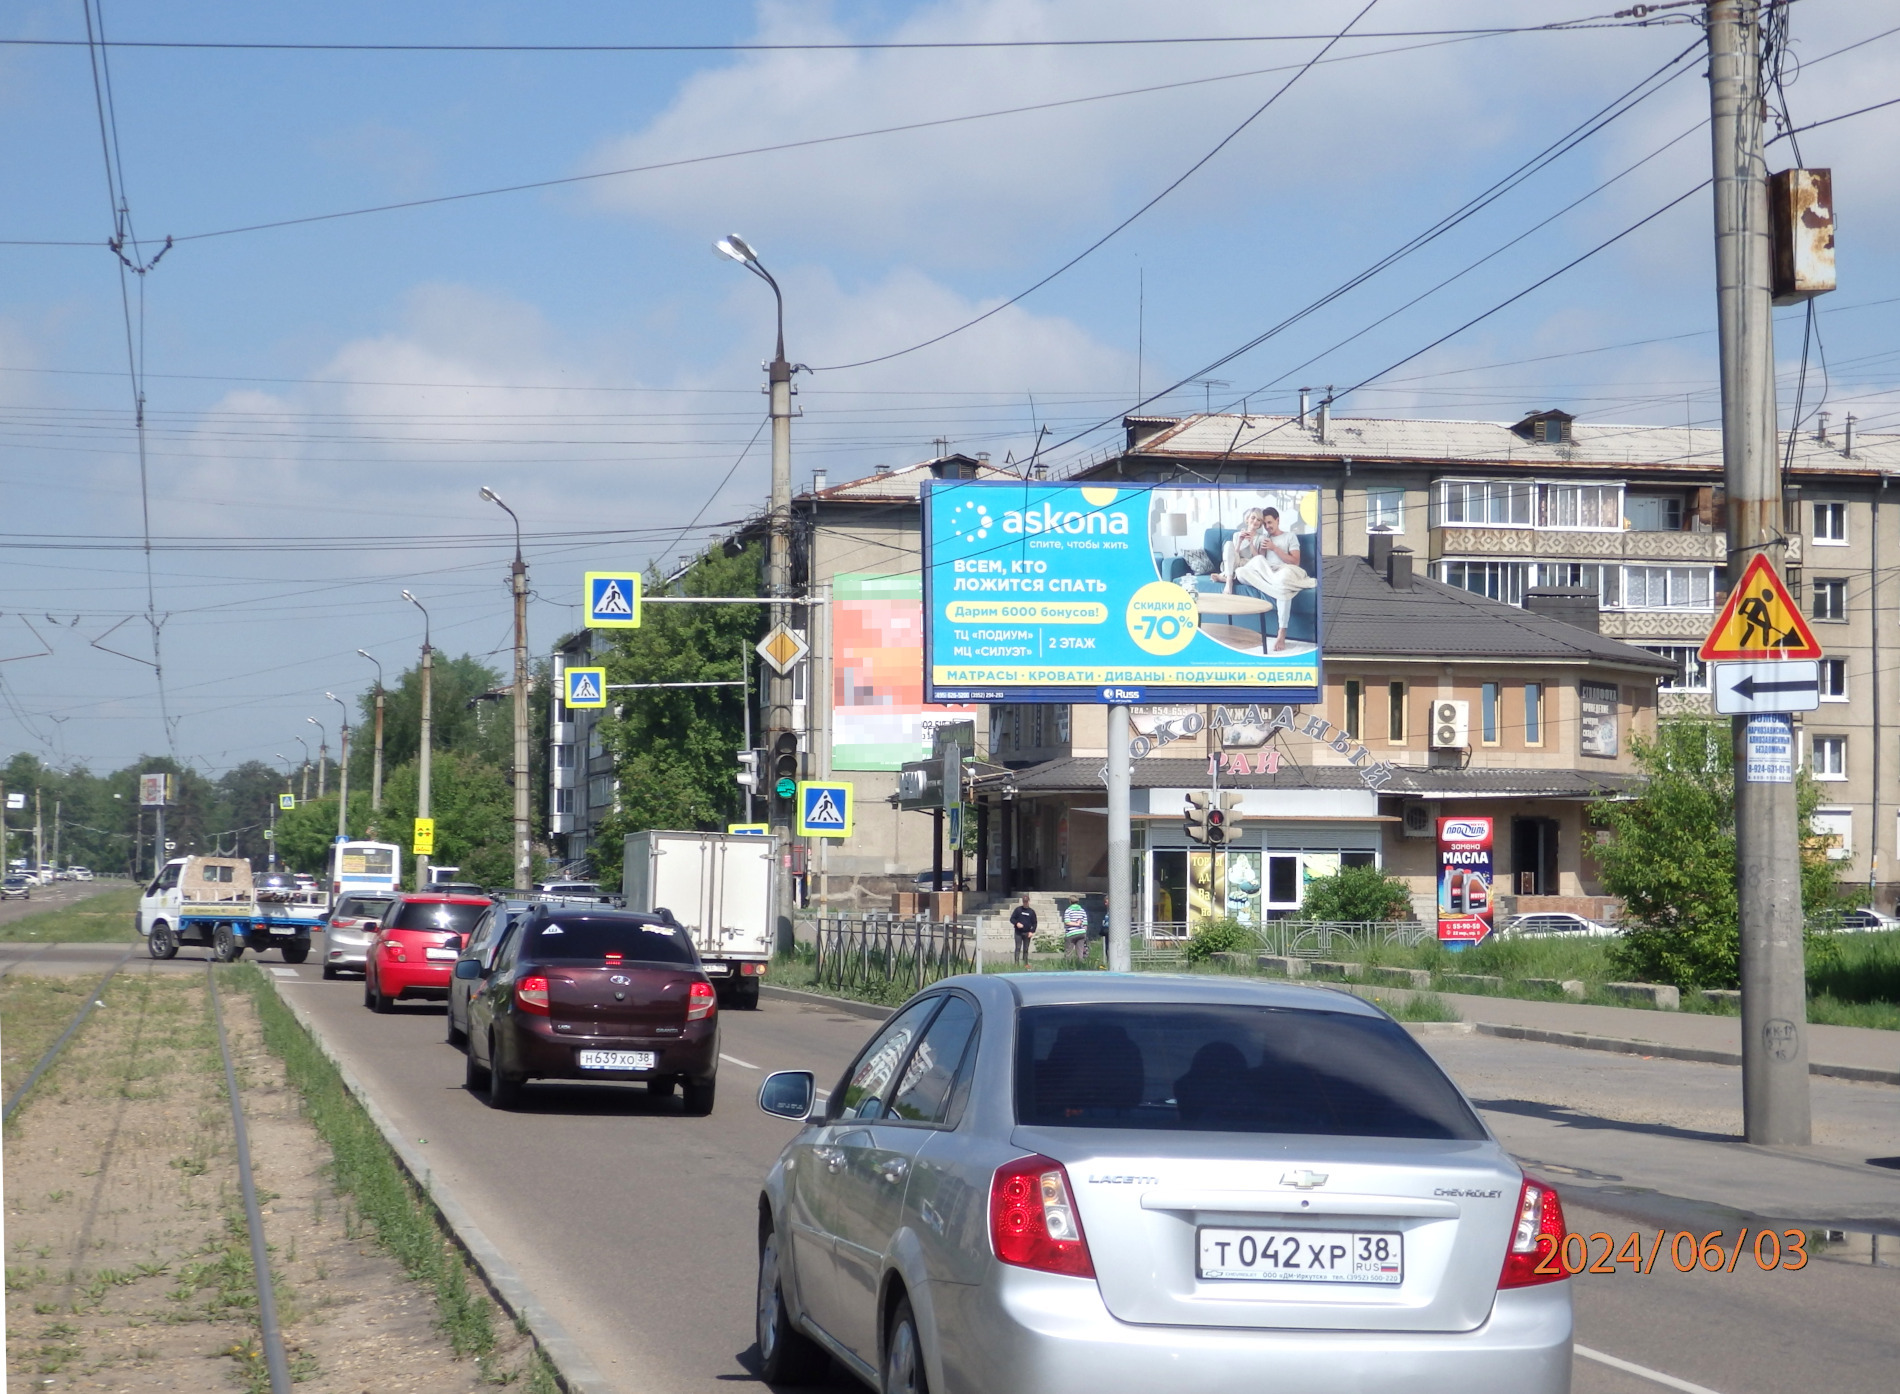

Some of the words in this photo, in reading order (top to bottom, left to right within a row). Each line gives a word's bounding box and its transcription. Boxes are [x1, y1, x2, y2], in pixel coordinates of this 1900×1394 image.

[1002, 502, 1129, 535] askona
[1029, 540, 1064, 550] спите,
[1067, 540, 1100, 549] чтобы
[1103, 541, 1128, 550] жить
[953, 560, 1007, 575] ВСЕМ,
[1011, 560, 1047, 573] КТО
[953, 578, 1044, 592] ЛОЖИТСЯ
[1048, 579, 1107, 592] СПАТЬ
[954, 606, 998, 619] Дарим
[1002, 607, 1037, 617] 6000
[1041, 607, 1099, 619] бонусов!
[1133, 602, 1175, 612] СКИДКИ
[1177, 602, 1192, 612] ДО
[1133, 615, 1194, 640] -70%
[954, 630, 969, 641] ТЦ
[972, 630, 1033, 641] «ПОДИУМ»
[1049, 638, 1057, 648] 2
[1059, 638, 1096, 649] ЭТАЖ
[954, 647, 972, 658] МЦ
[975, 647, 1032, 657] «СИЛУЭТ»
[947, 670, 1018, 681] МАТРАСЫ
[1028, 671, 1094, 681] КРОВАТИ
[1104, 671, 1165, 682] ДИВАНЫ
[1176, 671, 1247, 682] ПОДУШКИ
[1257, 671, 1313, 682] ОДЕЯЛА
[1115, 689, 1140, 699] Russ
[1098, 703, 1395, 790] ОКОЛАДНЫЙ
[1207, 745, 1281, 775] РАЙ
[1192, 856, 1223, 867] ТОРЫ
[1442, 851, 1489, 864] МАСЛА
[637, 1052, 649, 1062] 38
[1433, 1188, 1502, 1198] CHEVROLET
[1358, 1237, 1390, 1262] 38
[1356, 1262, 1380, 1272] RUS
